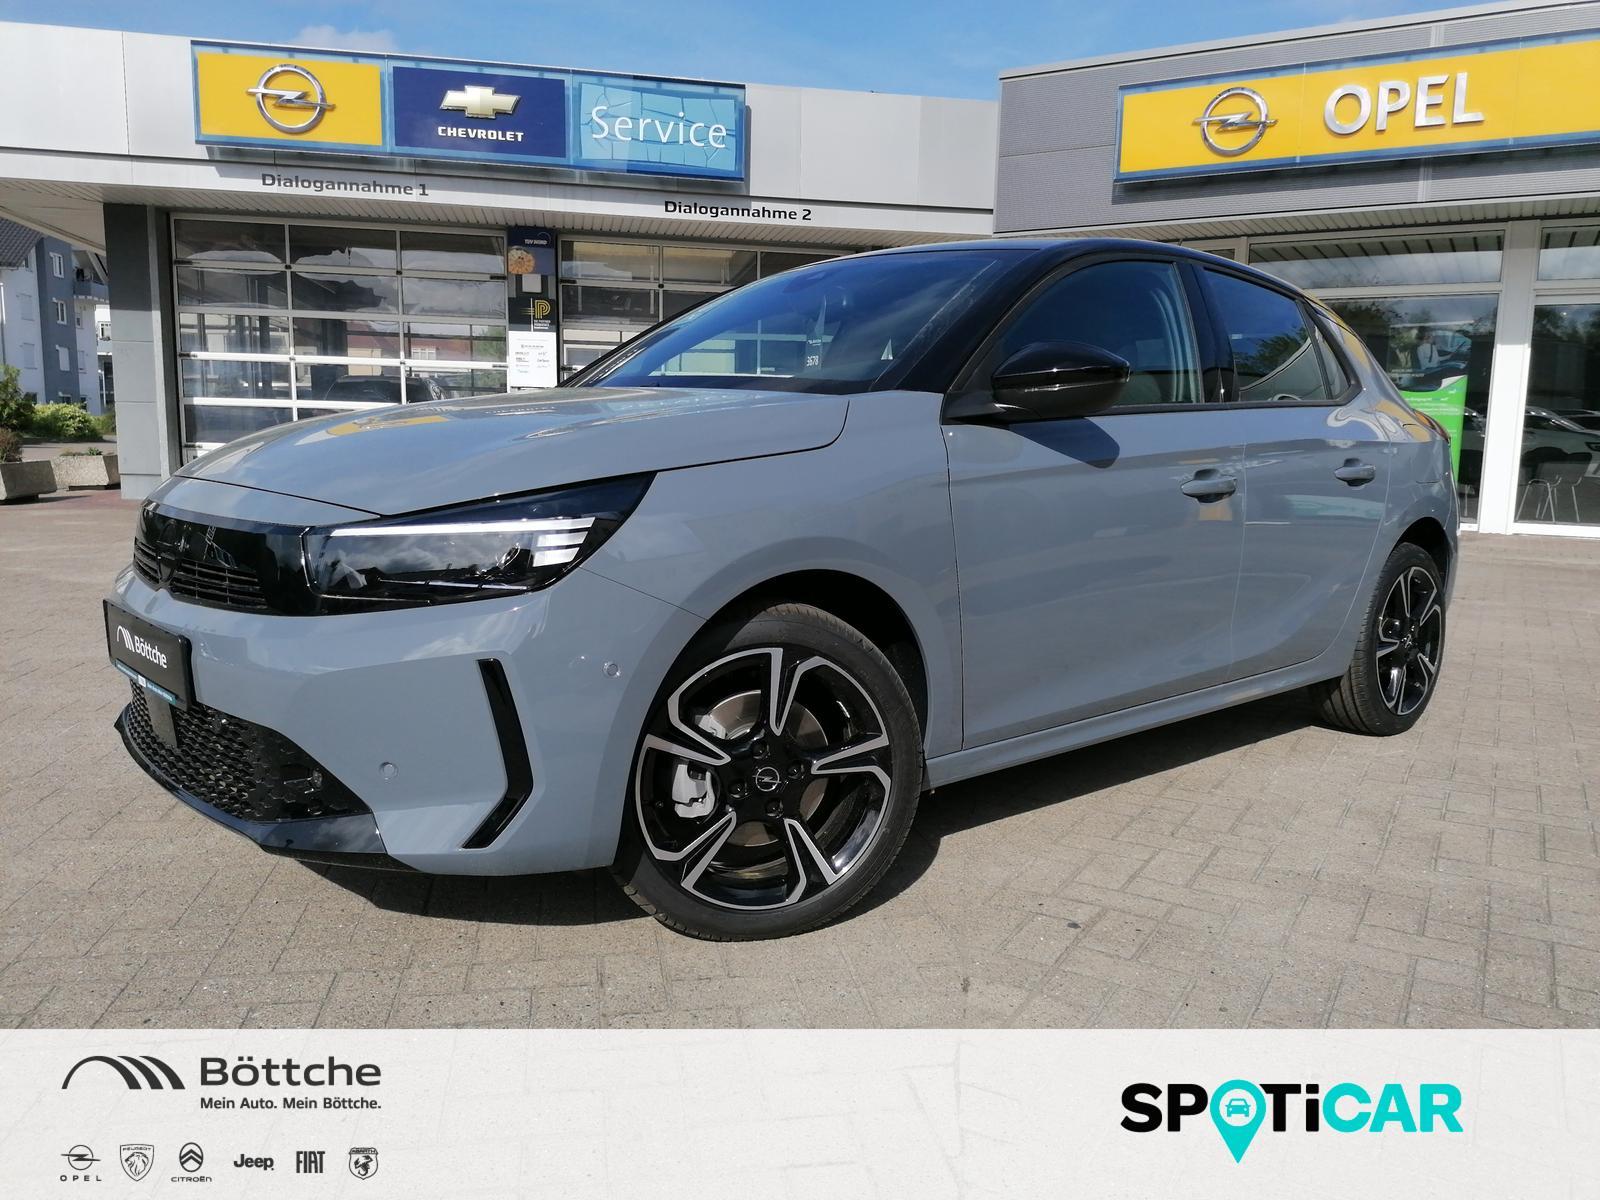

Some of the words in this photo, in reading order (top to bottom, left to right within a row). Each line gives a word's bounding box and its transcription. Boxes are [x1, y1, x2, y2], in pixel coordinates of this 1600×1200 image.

[1324, 72, 1485, 135] OPEL
[437, 126, 524, 142] CHEVROLET
[591, 105, 727, 149] Service
[261, 173, 413, 196] Dialogannahme
[419, 183, 429, 196] 1
[664, 200, 797, 220] Dialogannahme
[802, 209, 812, 221] 2
[134, 635, 167, 669] Böttche
